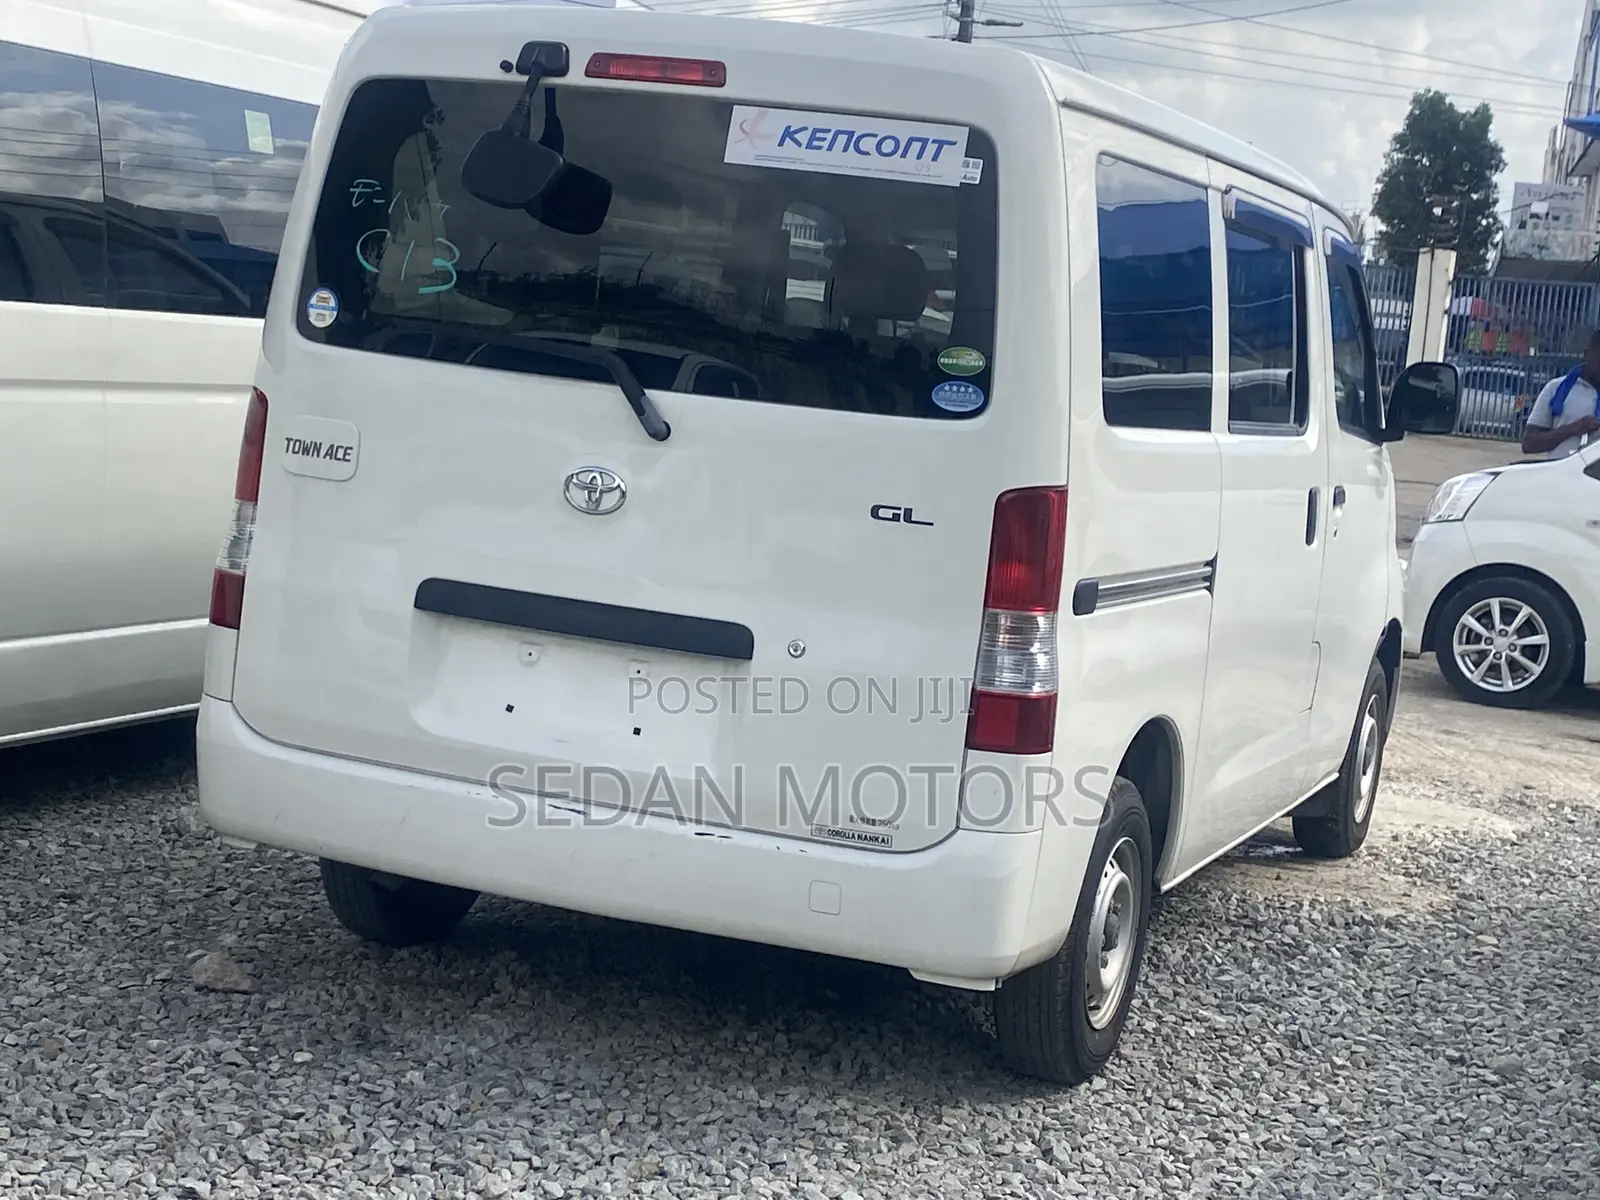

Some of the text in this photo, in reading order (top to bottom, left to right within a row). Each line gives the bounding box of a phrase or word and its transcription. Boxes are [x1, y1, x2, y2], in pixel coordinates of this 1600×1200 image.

[285, 436, 353, 463] TOWN ACE
[870, 504, 934, 527] GL
[827, 828, 890, 845] COROLLA NANKAI
